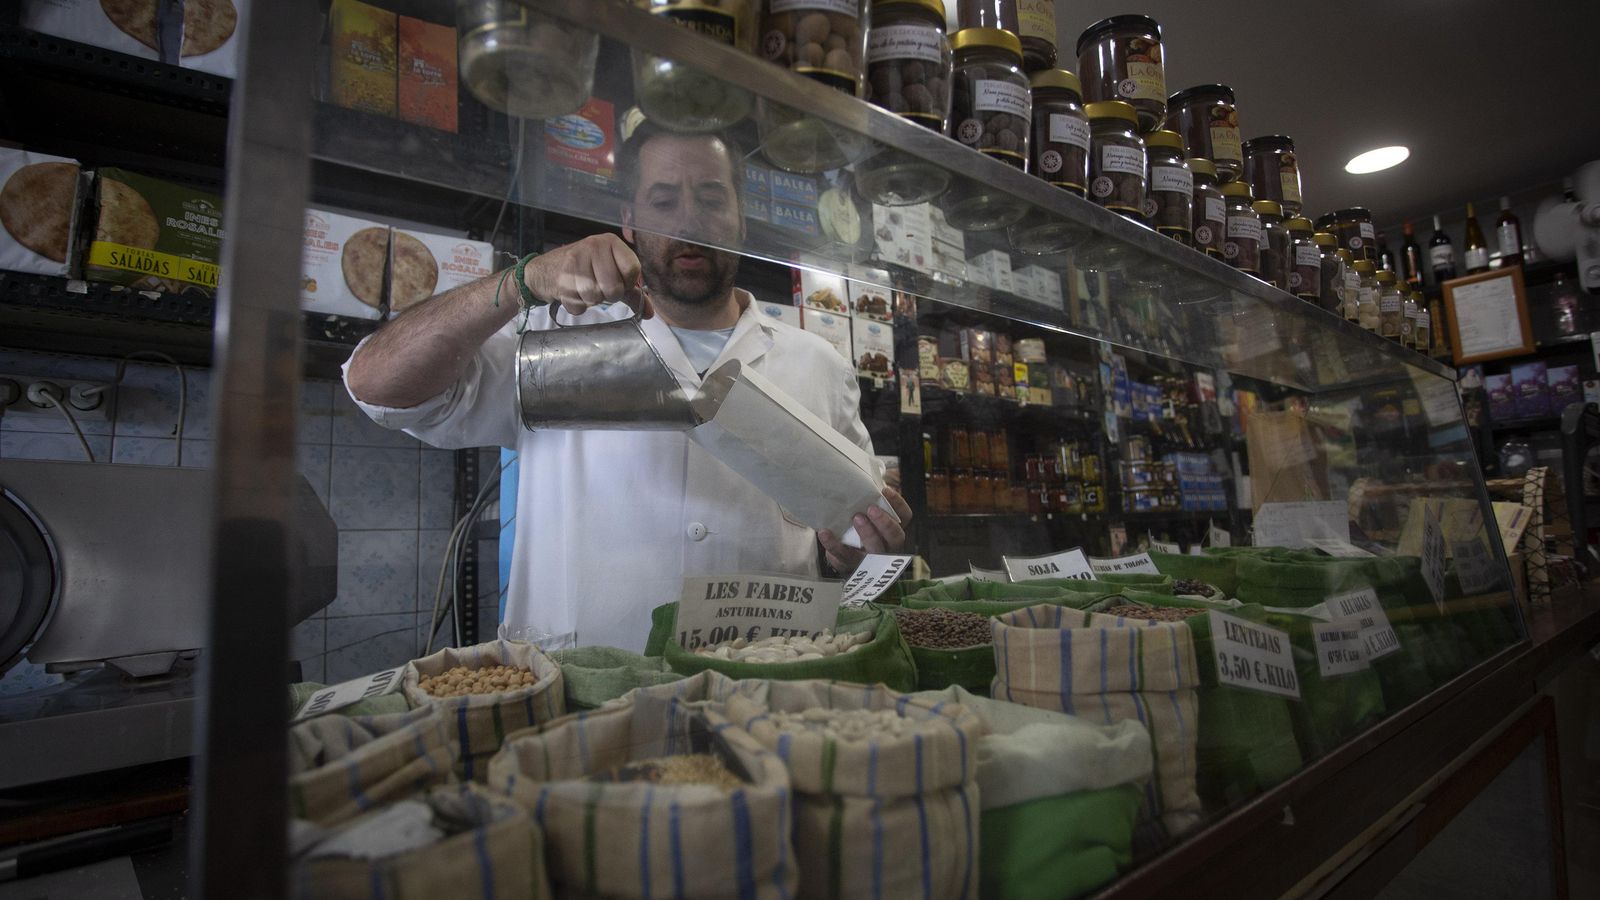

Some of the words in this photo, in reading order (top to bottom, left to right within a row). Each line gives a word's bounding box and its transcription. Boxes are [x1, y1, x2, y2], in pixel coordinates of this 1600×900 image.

[775, 175, 814, 193] BALEA
[184, 211, 219, 228] INES
[775, 206, 814, 224] BALEA
[109, 251, 169, 276] SALADAS
[1027, 562, 1060, 576] SOJA
[1113, 563, 1122, 572] DE
[1124, 557, 1149, 570] TOLOSA
[704, 581, 741, 601] LES
[745, 581, 815, 605] FABES
[715, 606, 793, 621] ASTURIANAS
[1223, 620, 1281, 655] LENTEJAS
[1219, 652, 1251, 681] 3,50
